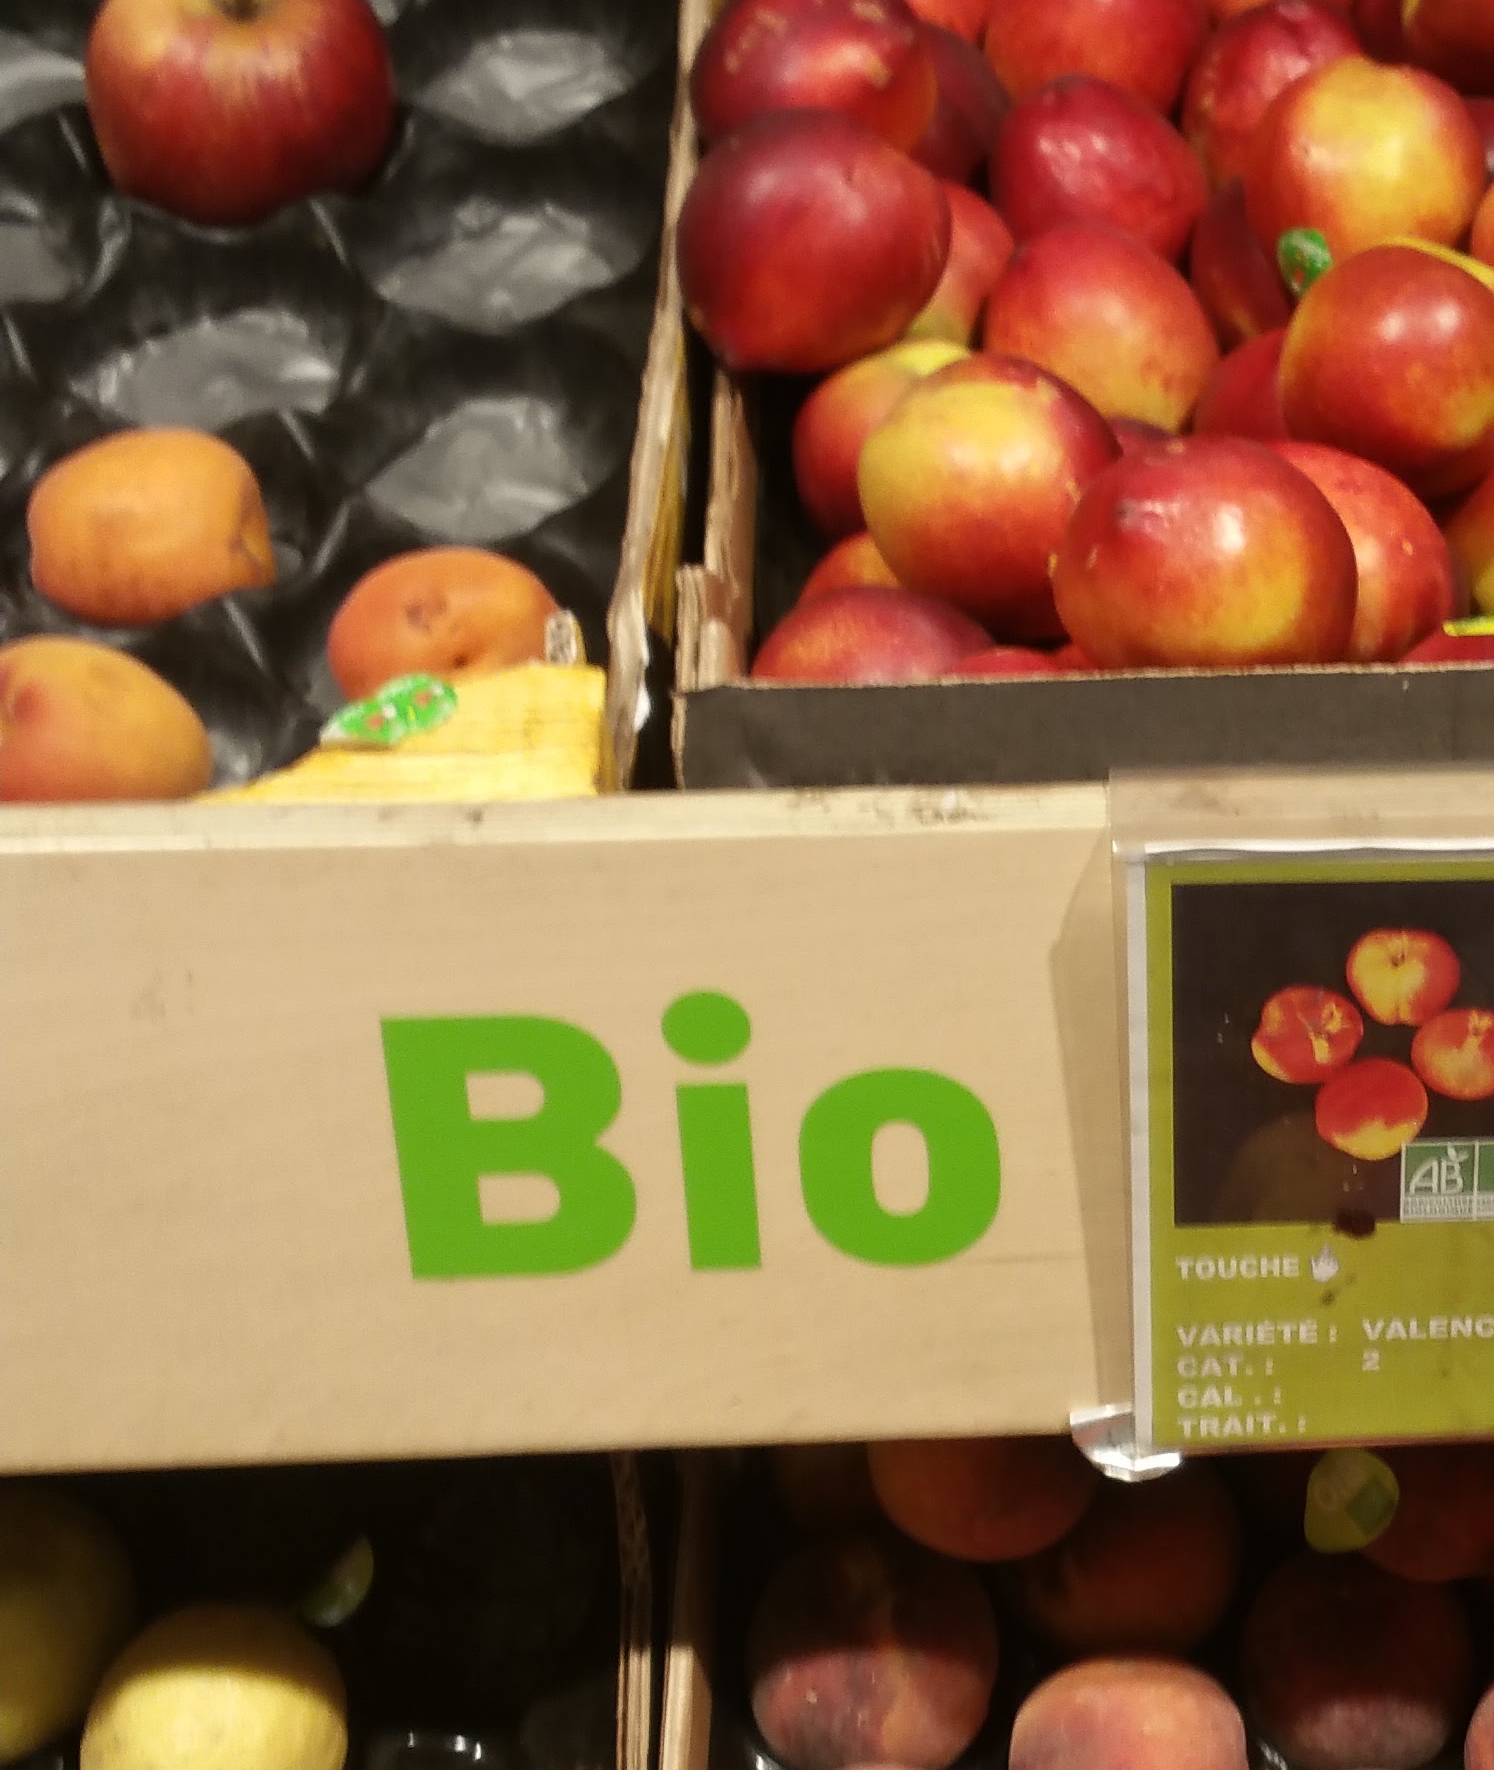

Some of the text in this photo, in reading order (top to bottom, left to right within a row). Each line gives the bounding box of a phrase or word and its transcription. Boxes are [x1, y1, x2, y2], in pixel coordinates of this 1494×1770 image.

[380, 988, 1001, 1280] Bio
[1176, 1255, 1299, 1280] TOUCHE
[1362, 1348, 1380, 1371] 2
